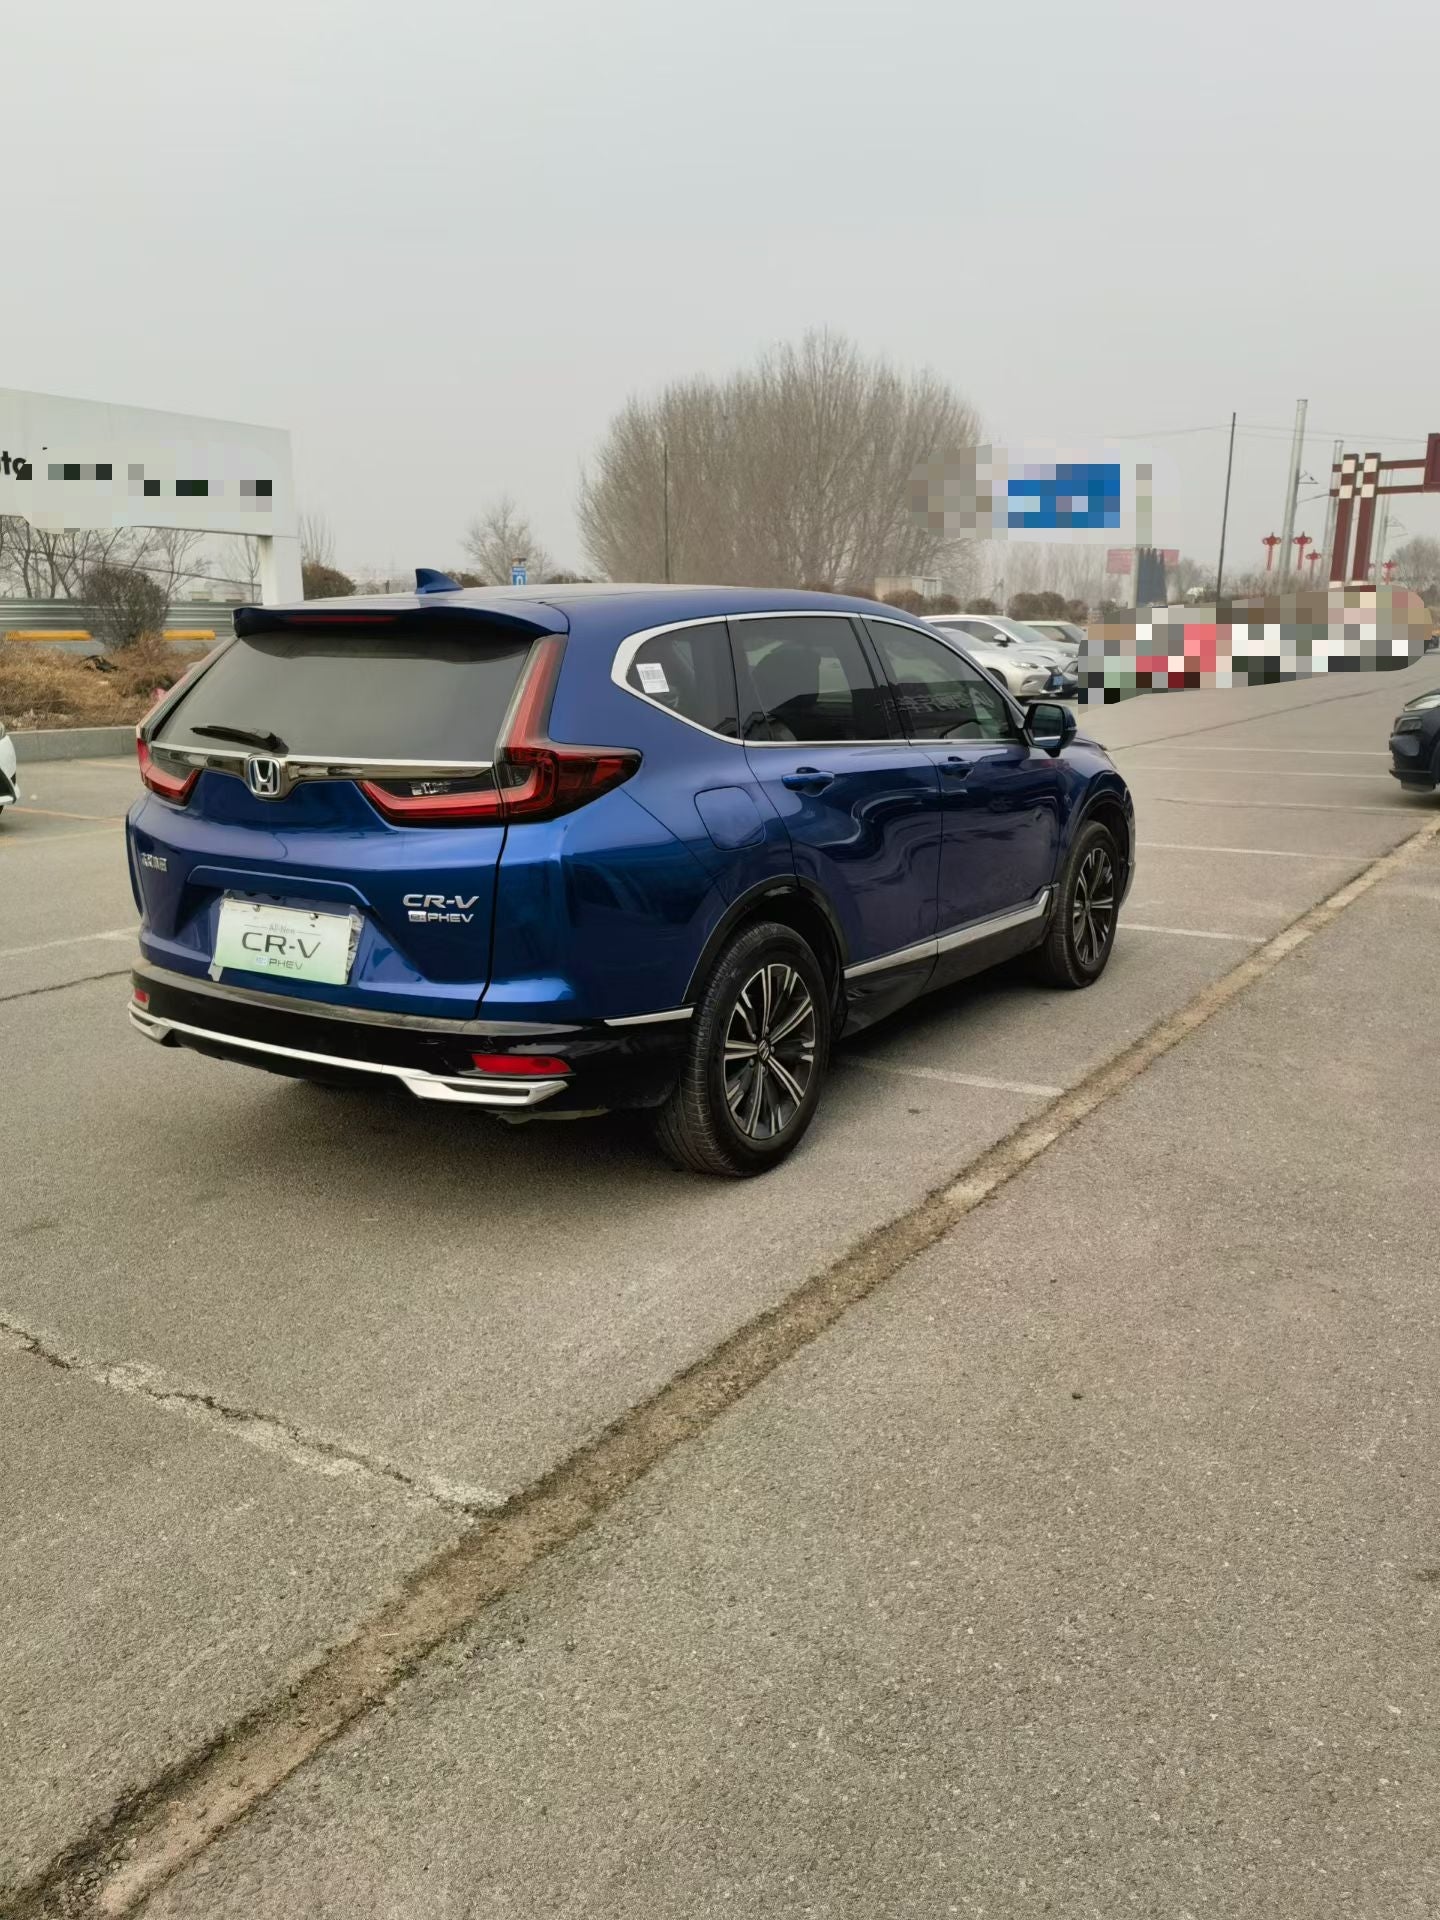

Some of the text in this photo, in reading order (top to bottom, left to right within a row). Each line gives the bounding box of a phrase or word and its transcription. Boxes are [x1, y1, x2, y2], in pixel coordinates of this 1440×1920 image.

[402, 893, 480, 909] CR-V
[427, 912, 475, 923] PHEV
[241, 931, 321, 959] CR-V
[268, 957, 304, 971] PHEV
